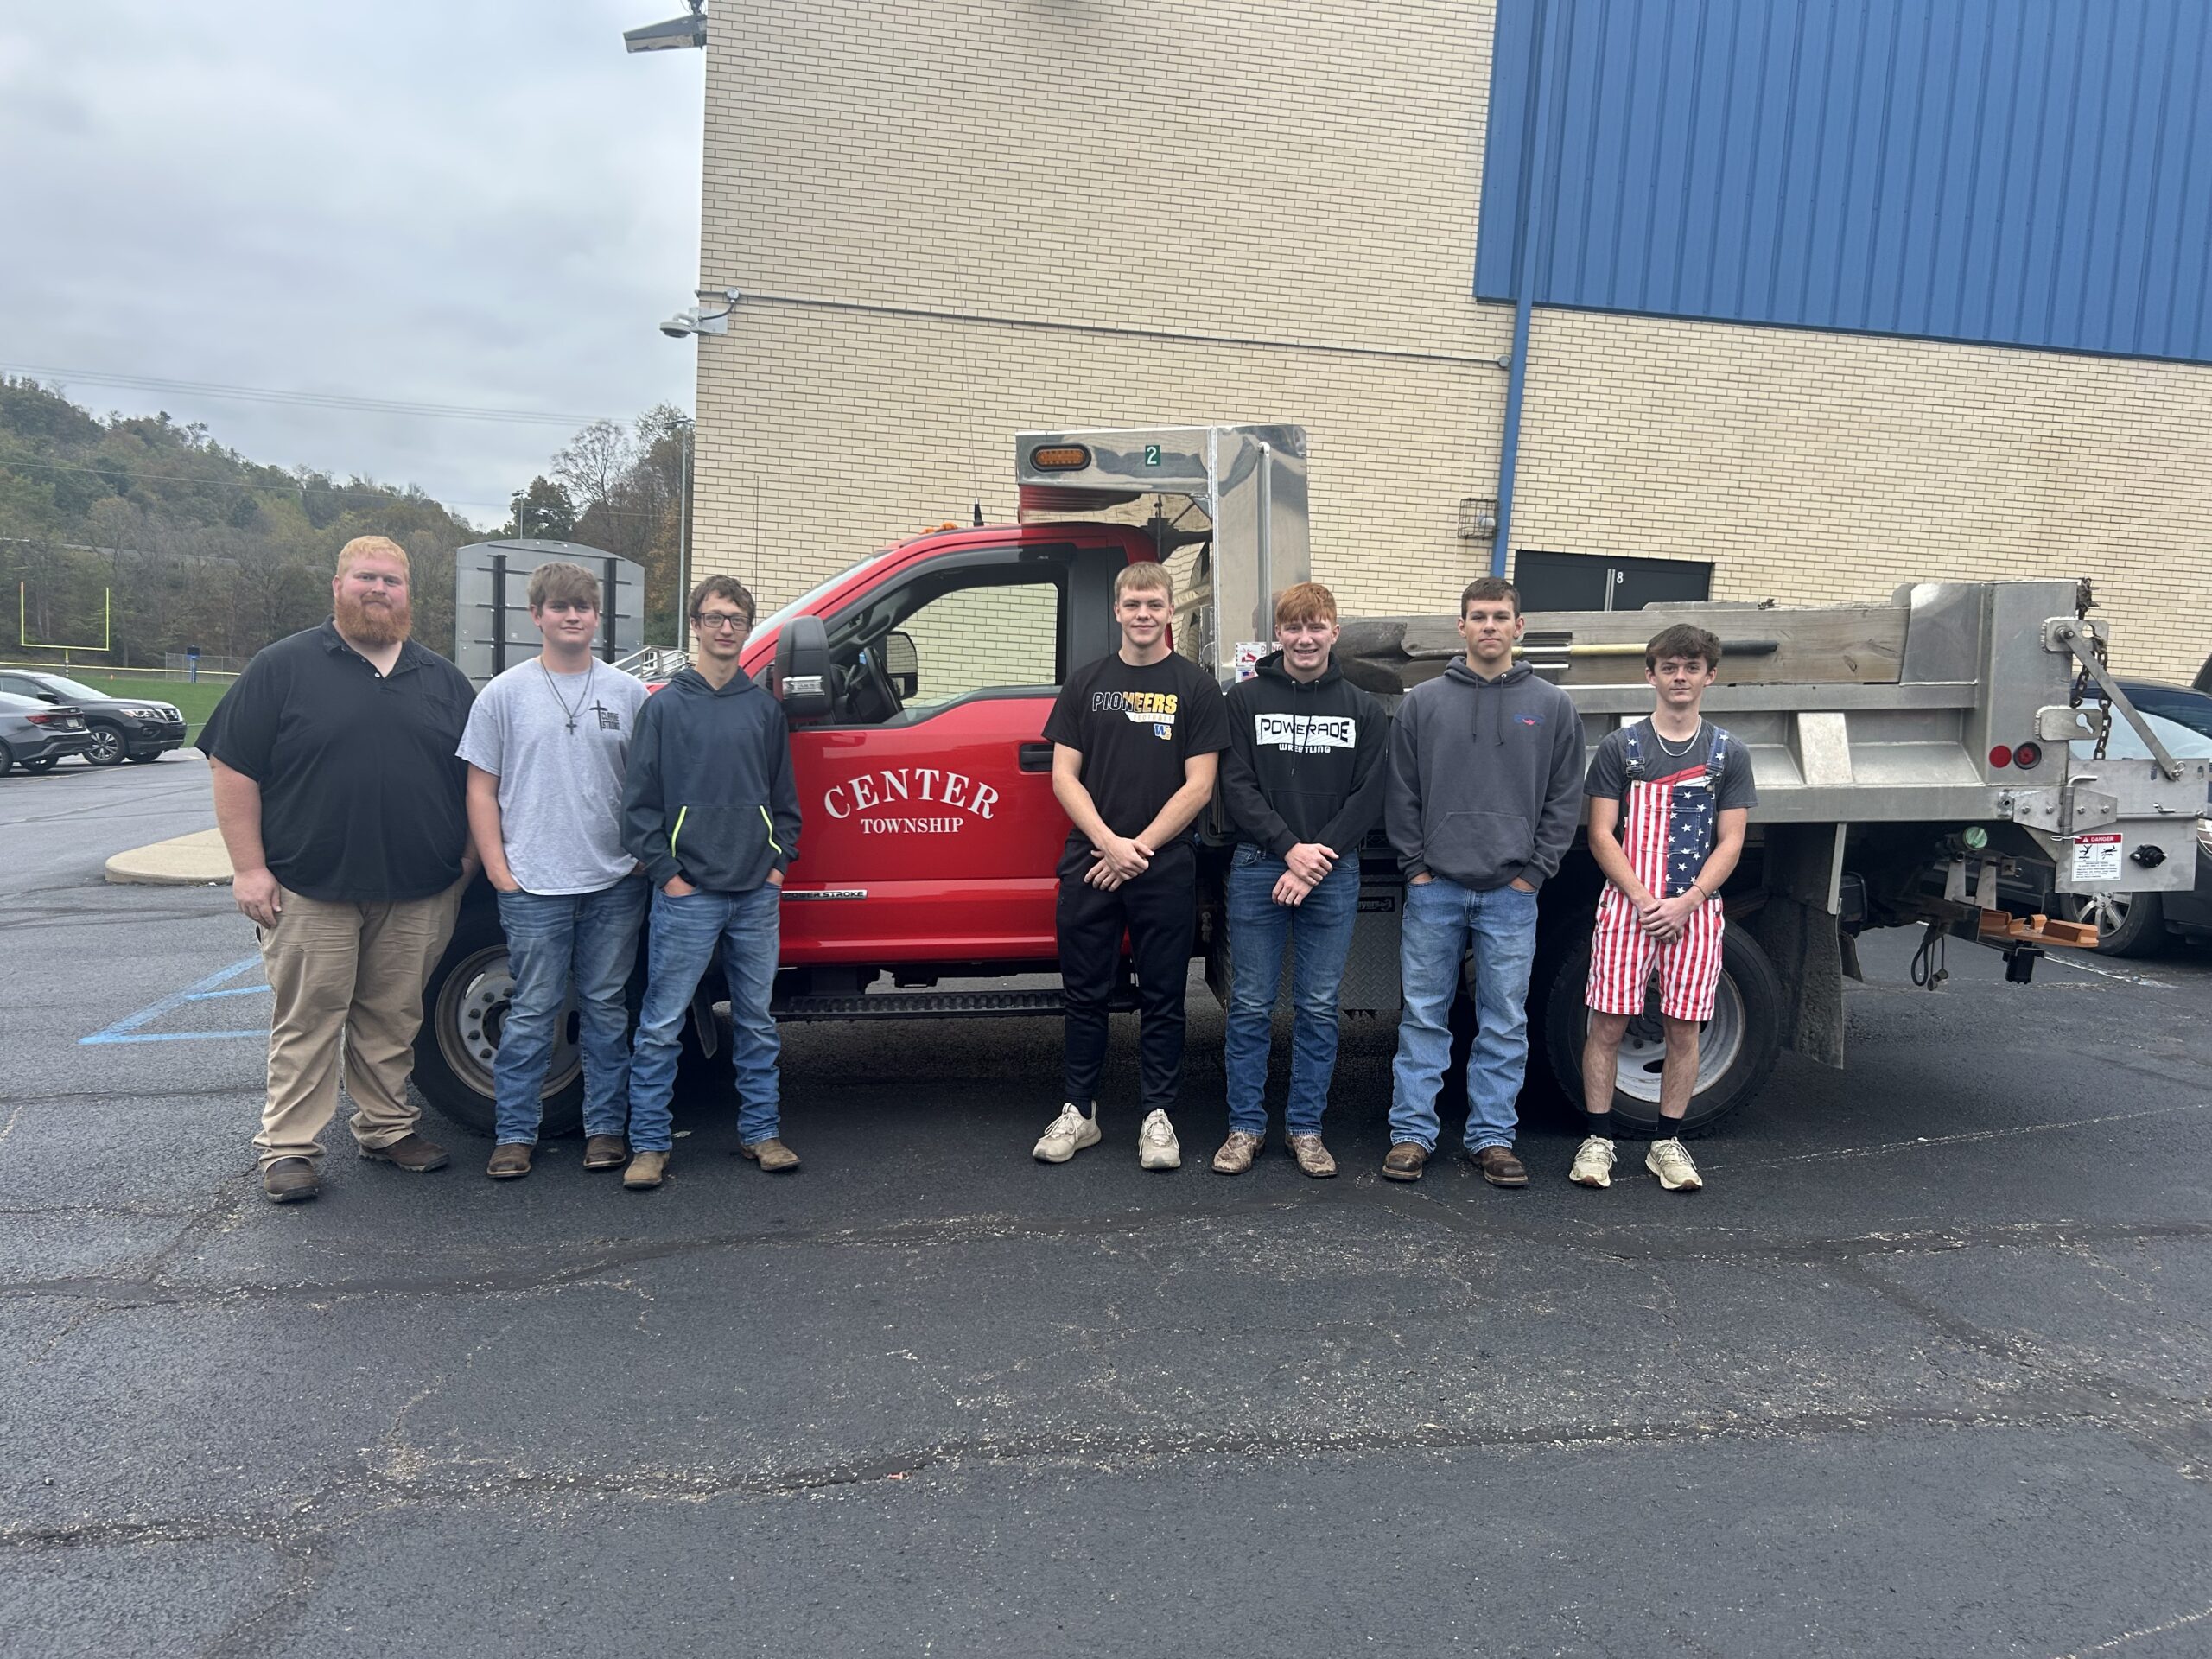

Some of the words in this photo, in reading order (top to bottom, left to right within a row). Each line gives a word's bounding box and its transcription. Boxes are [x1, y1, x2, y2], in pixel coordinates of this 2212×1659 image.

[1147, 446, 1157, 465] 2
[1616, 571, 1624, 584] 8
[1092, 691, 1178, 714] PIONEERS
[1133, 714, 1173, 722] FOOTBALL
[1260, 718, 1350, 743] POWERADE
[1279, 743, 1331, 753] WRESTLING
[823, 767, 999, 819] CENTER
[861, 817, 964, 834] TOWNSHIP
